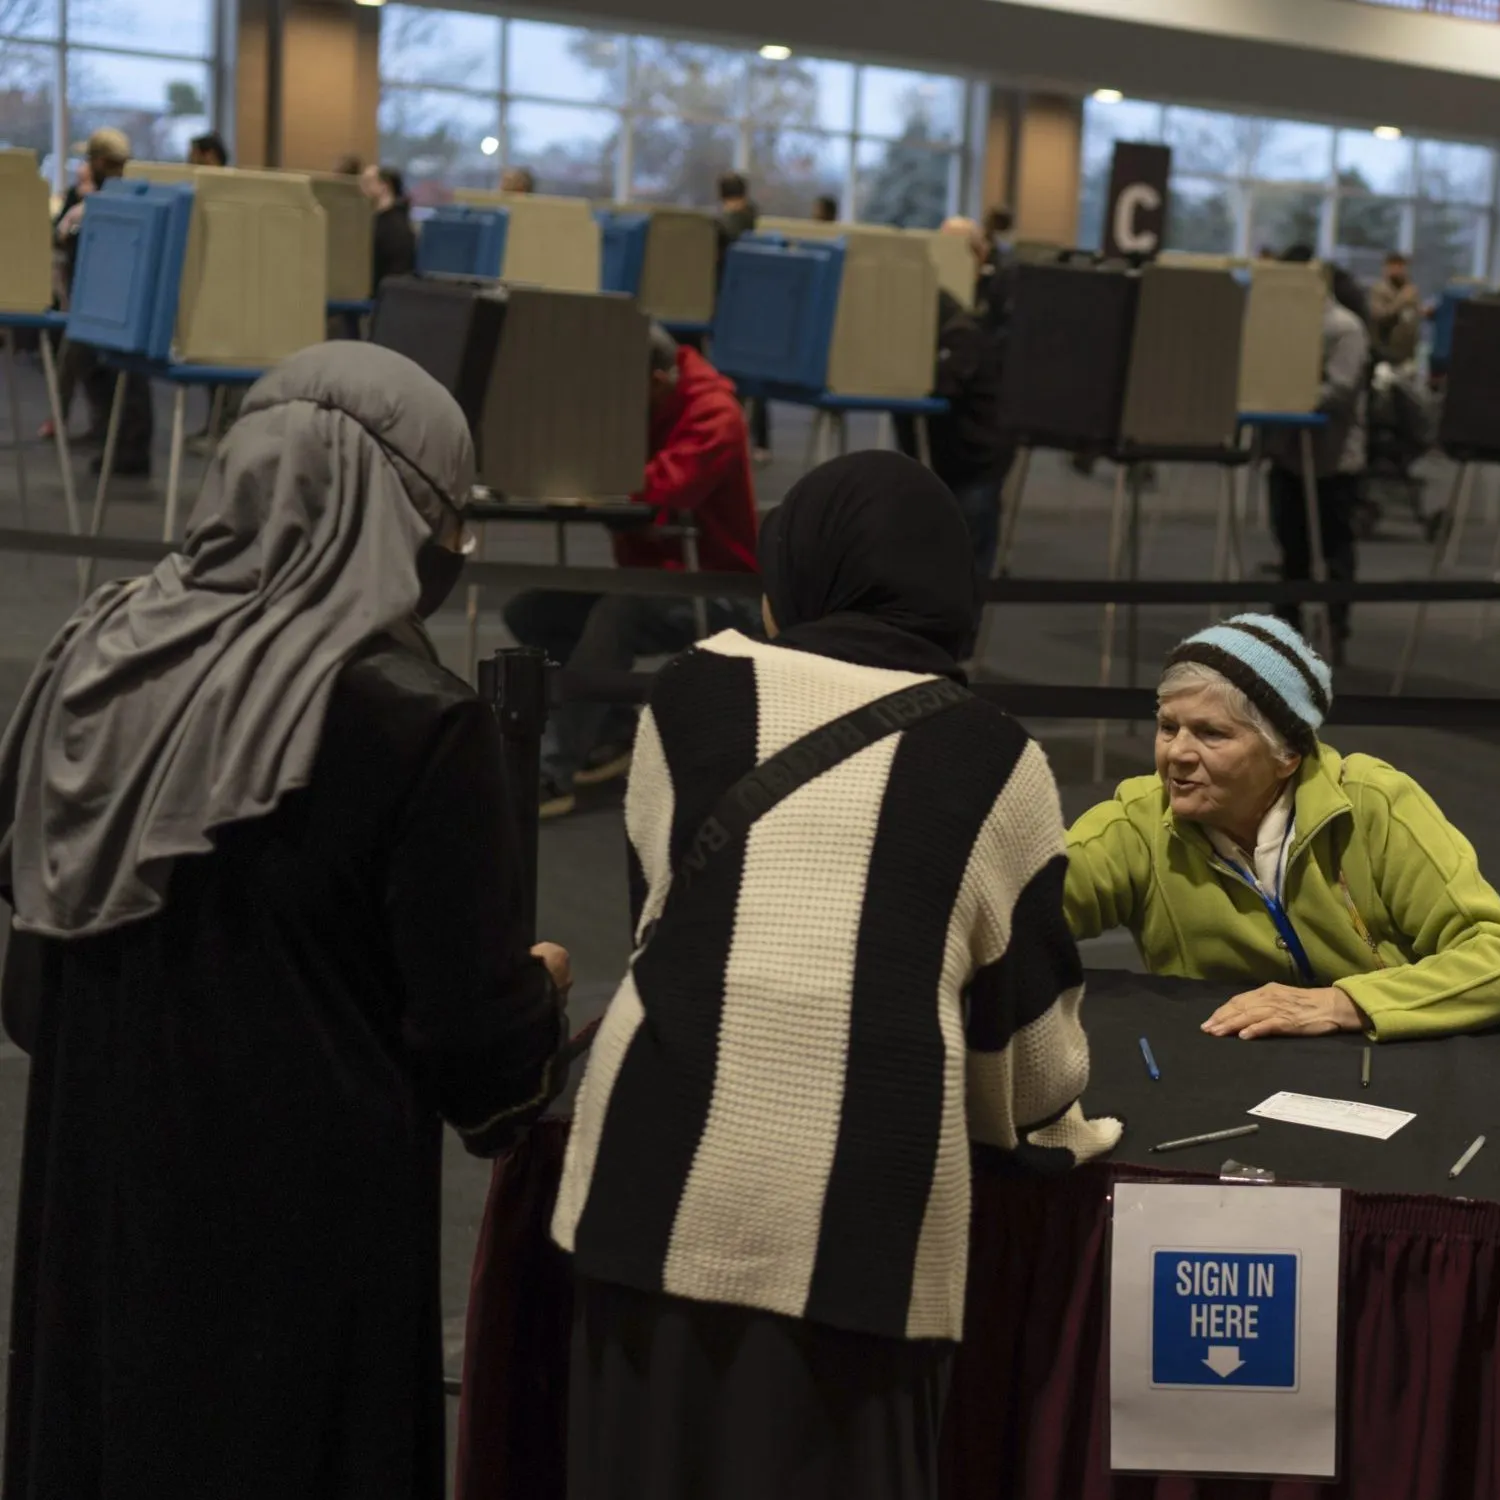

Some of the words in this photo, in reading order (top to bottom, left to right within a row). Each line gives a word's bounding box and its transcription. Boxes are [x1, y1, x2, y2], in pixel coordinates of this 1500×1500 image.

[1114, 183, 1161, 253] C
[1176, 1260, 1239, 1297] SIGN
[1248, 1262, 1274, 1297] IN
[1190, 1303, 1259, 1338] HERE
